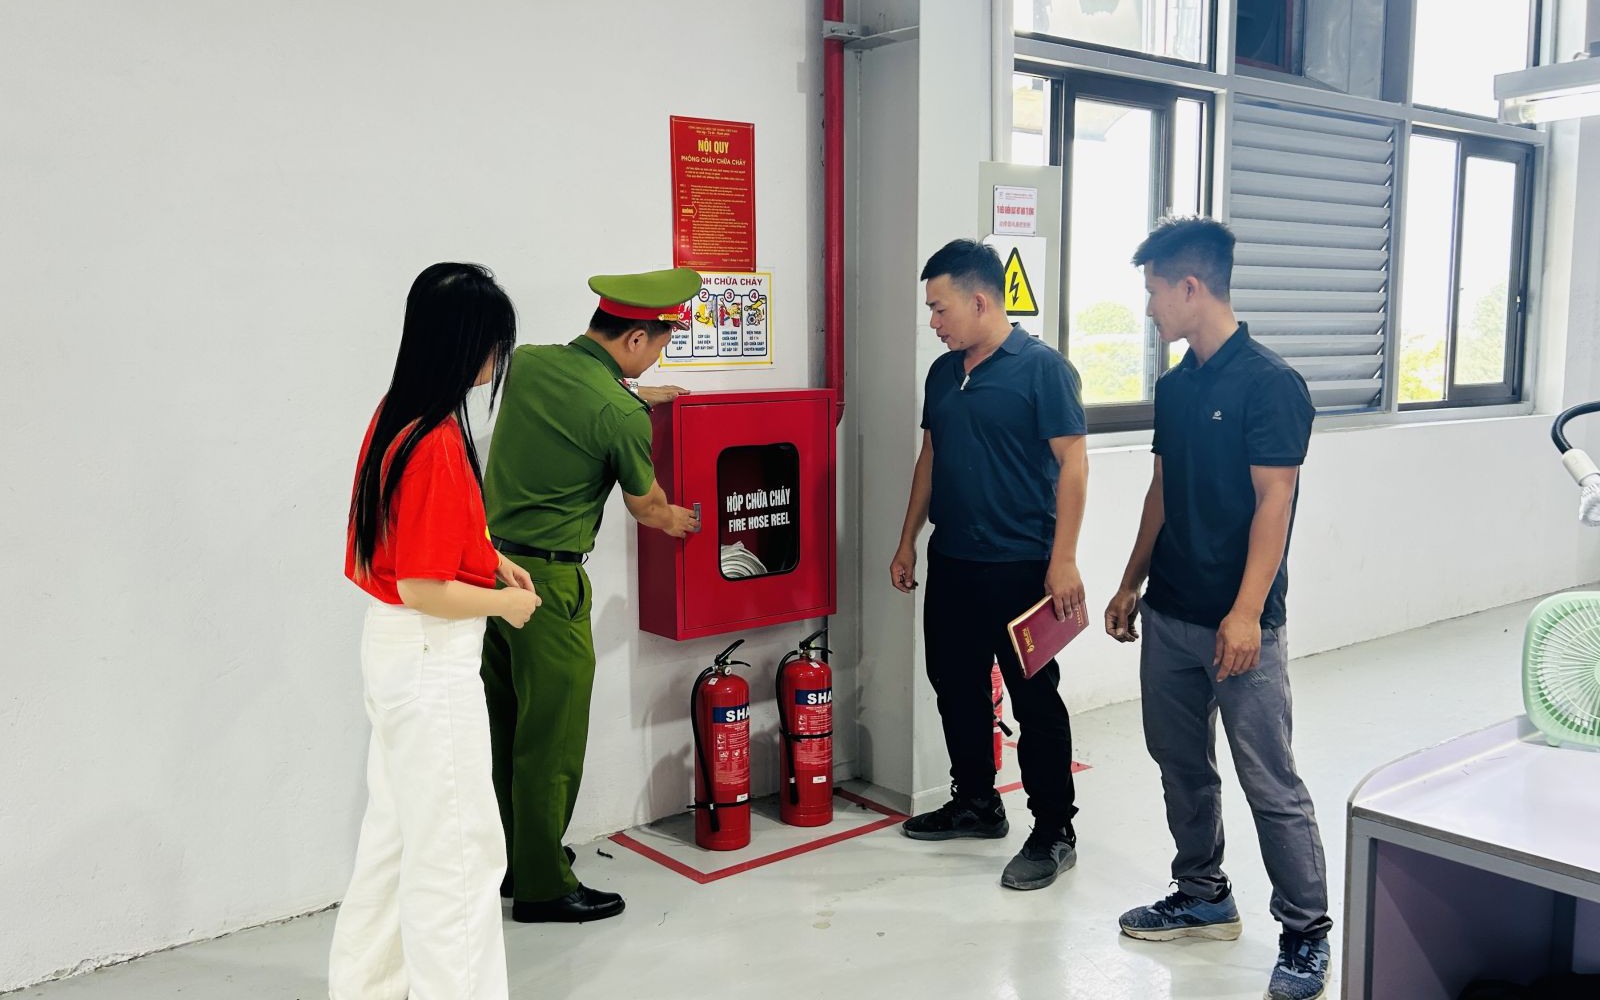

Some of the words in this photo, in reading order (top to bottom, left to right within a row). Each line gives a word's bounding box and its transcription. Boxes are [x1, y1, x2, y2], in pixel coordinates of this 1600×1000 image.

[698, 138, 711, 155] NỘI
[714, 141, 729, 154] QUY
[681, 154, 700, 163] PHÒNG
[701, 156, 715, 164] CHÁY
[702, 277, 711, 285] NH
[714, 276, 737, 285] CHỮA
[740, 277, 763, 286] CHÁY
[726, 492, 743, 516] HỘP
[745, 489, 768, 510] CHỮA
[769, 485, 791, 507] CHÁY
[728, 517, 747, 533] FIRE
[748, 514, 769, 530] HOSE
[771, 512, 790, 527] REEL
